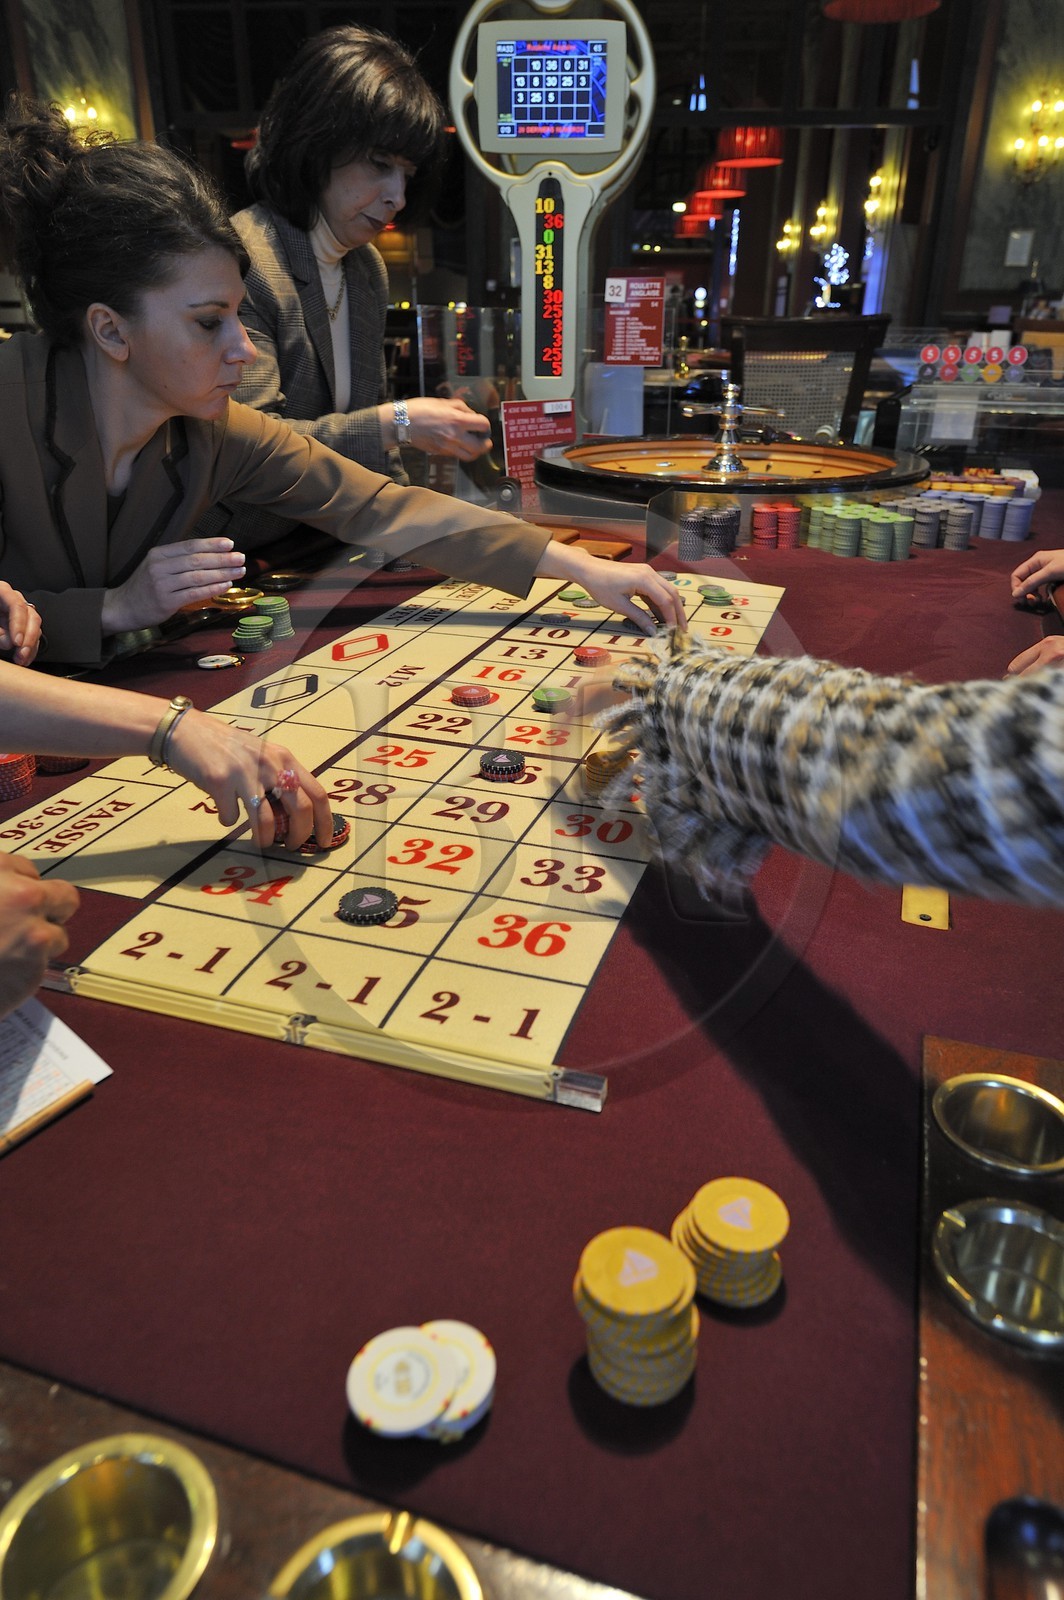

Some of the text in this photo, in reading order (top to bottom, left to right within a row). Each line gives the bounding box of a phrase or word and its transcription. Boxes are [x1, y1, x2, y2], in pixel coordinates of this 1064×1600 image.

[531, 60, 541, 71] 10
[563, 60, 571, 71] 0
[578, 60, 589, 71] 31
[546, 76, 558, 87] 30
[562, 76, 573, 87] 25
[579, 76, 587, 87] 3
[516, 92, 555, 103] 3 25 5
[535, 197, 555, 213] 10
[543, 213, 564, 229] 36
[543, 229, 554, 244] 0
[535, 244, 554, 260] 31
[535, 260, 554, 274] 13
[543, 274, 554, 289] 8
[543, 289, 563, 304] 30
[608, 285, 622, 297] 32
[542, 304, 563, 318] 25
[552, 319, 562, 333] 3
[552, 333, 562, 347] 3
[542, 347, 562, 361] 25
[551, 361, 562, 375] 5
[385, 603, 425, 621] EVEN
[414, 606, 452, 622] PAIR
[720, 611, 741, 620] 6
[523, 626, 571, 639] 10
[709, 626, 733, 637] 9
[603, 635, 646, 647] 11
[498, 646, 548, 660] 13
[375, 664, 426, 687] M12
[471, 665, 527, 682] 16
[406, 713, 473, 735] 22
[505, 725, 570, 746] 23
[362, 744, 437, 768] 25
[327, 778, 396, 806] 28
[430, 795, 510, 824] 29
[0, 798, 83, 841] 19-36
[32, 799, 136, 853] PASSE
[554, 813, 634, 844] 30
[386, 838, 474, 875] 32
[520, 858, 606, 894] 33
[200, 866, 295, 906] 34
[477, 914, 572, 957] 36
